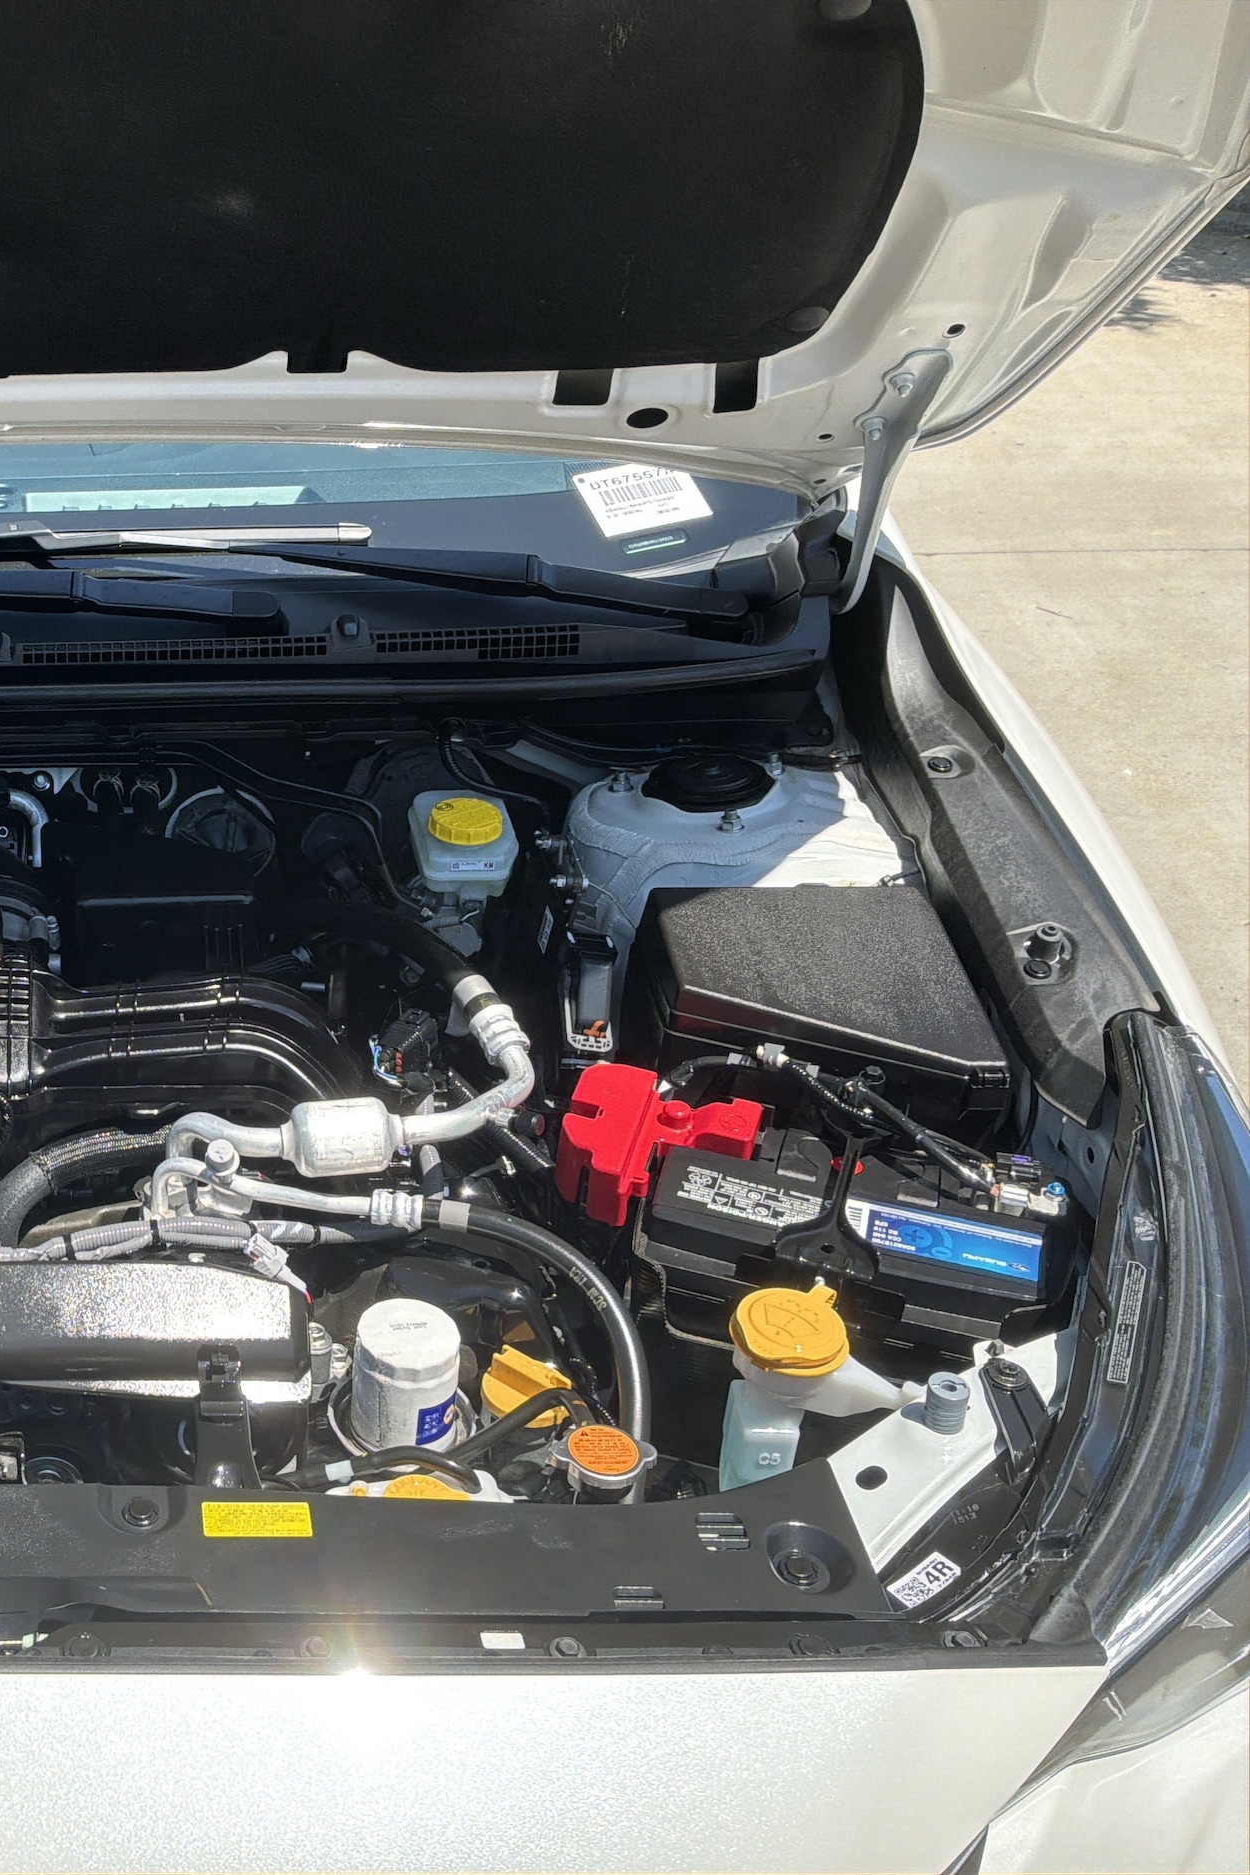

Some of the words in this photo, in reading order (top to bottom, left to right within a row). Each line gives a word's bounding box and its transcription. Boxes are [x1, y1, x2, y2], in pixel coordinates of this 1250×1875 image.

[707, 1203, 786, 1227] ANGER/POISON
[887, 1234, 902, 1242] CCA
[962, 1252, 1008, 1267] SUBARU
[758, 1451, 782, 1466] C5
[924, 1560, 953, 1584] 4R
